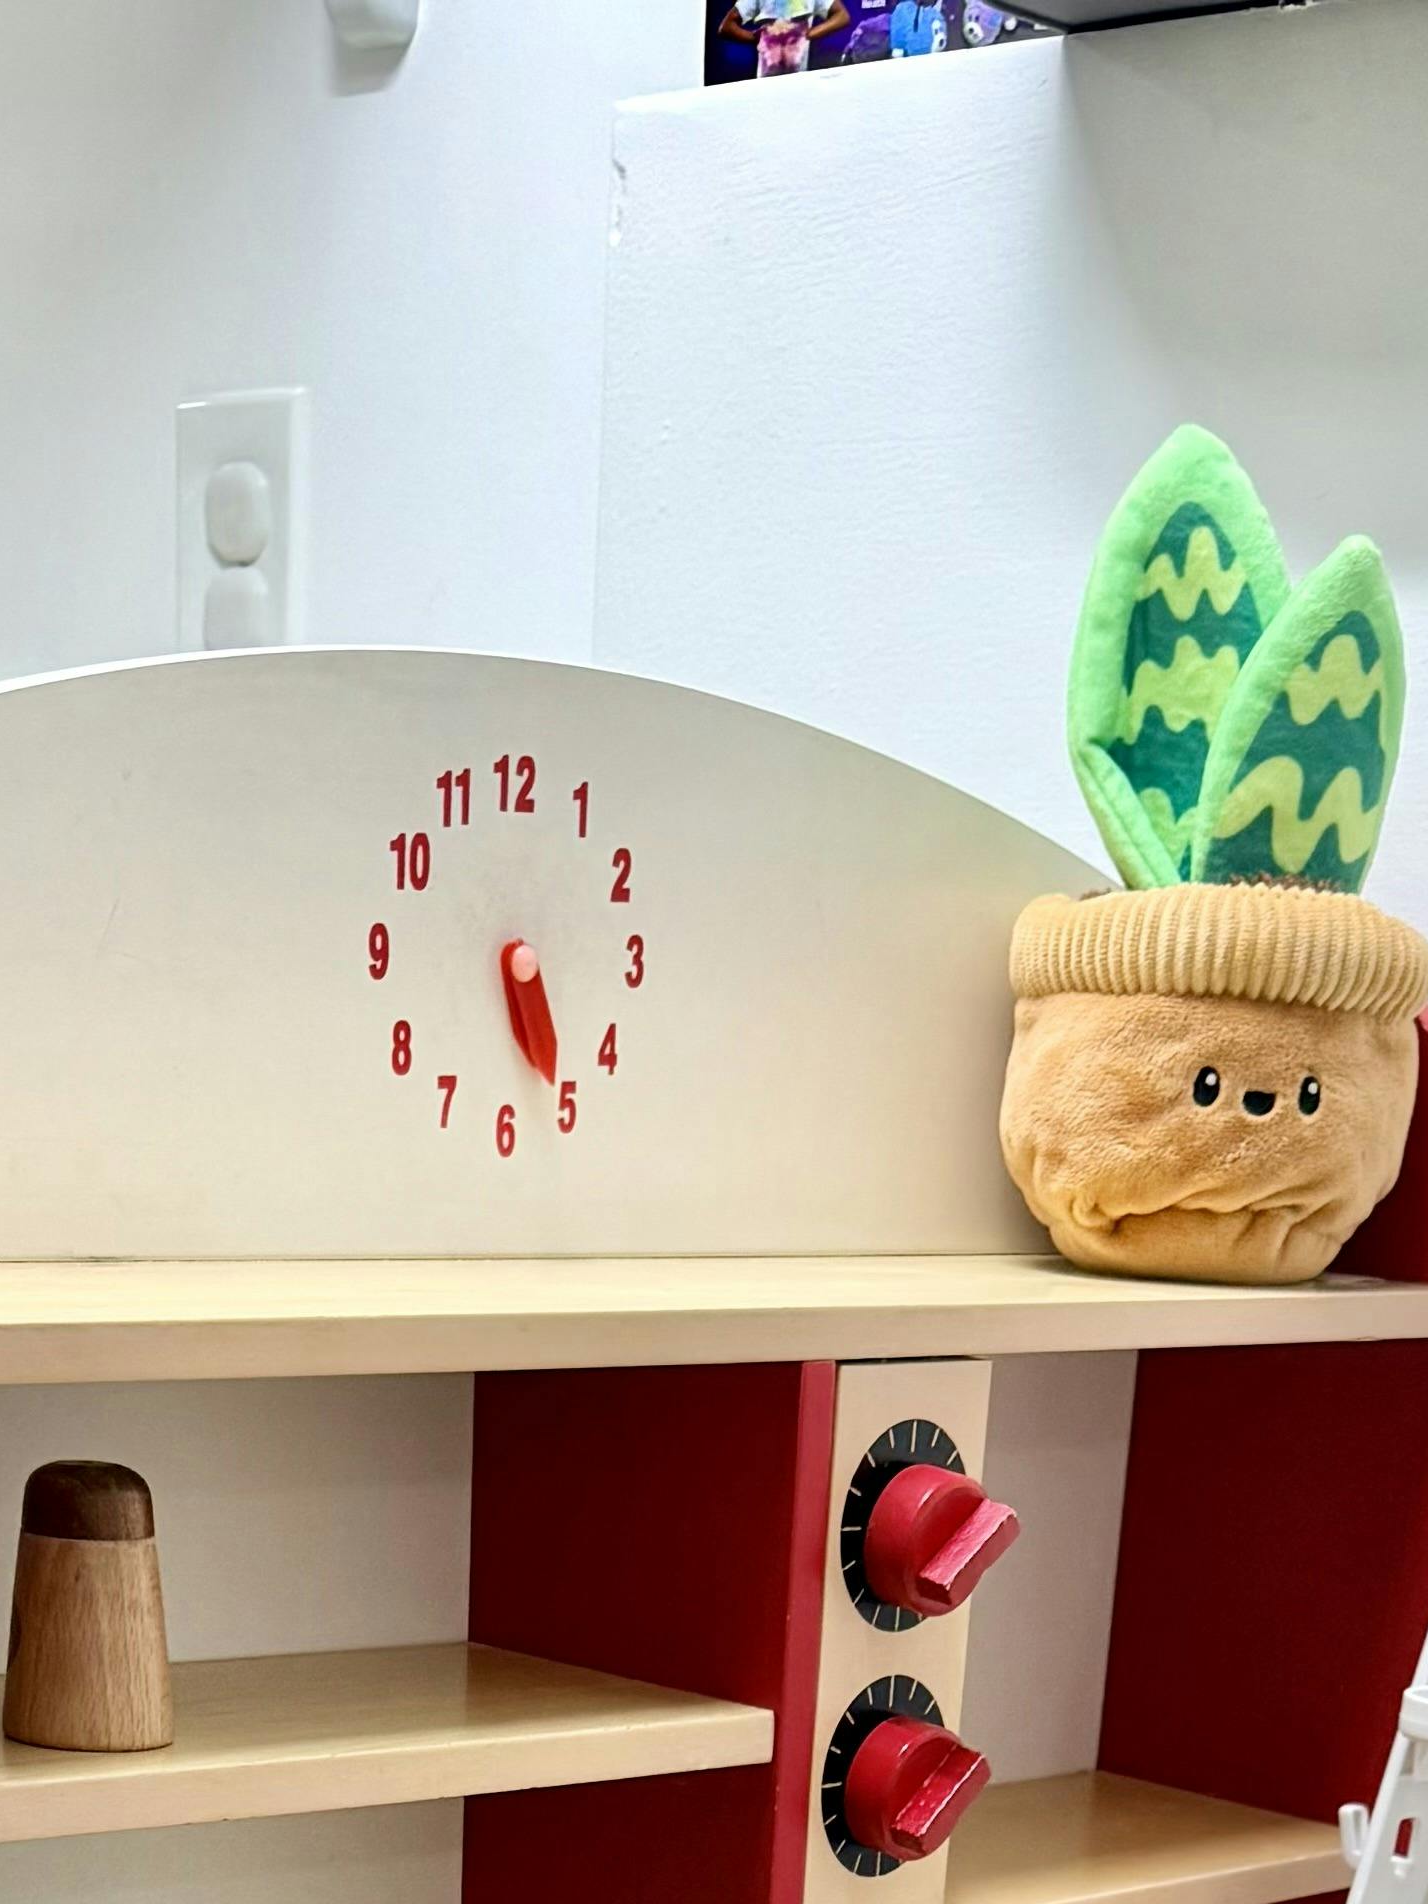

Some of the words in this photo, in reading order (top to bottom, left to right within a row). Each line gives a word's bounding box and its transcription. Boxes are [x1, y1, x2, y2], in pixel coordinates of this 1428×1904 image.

[436, 768, 471, 828] 11
[493, 754, 536, 813] 12
[572, 781, 589, 838] 1
[389, 832, 430, 891] 10
[610, 848, 632, 903] 2
[368, 922, 390, 980] 9
[625, 934, 644, 989] 3
[391, 1019, 412, 1075] 8
[597, 1023, 618, 1075] 4
[437, 1075, 457, 1129] 7
[557, 1080, 577, 1134] 5
[496, 1104, 516, 1157] 6
